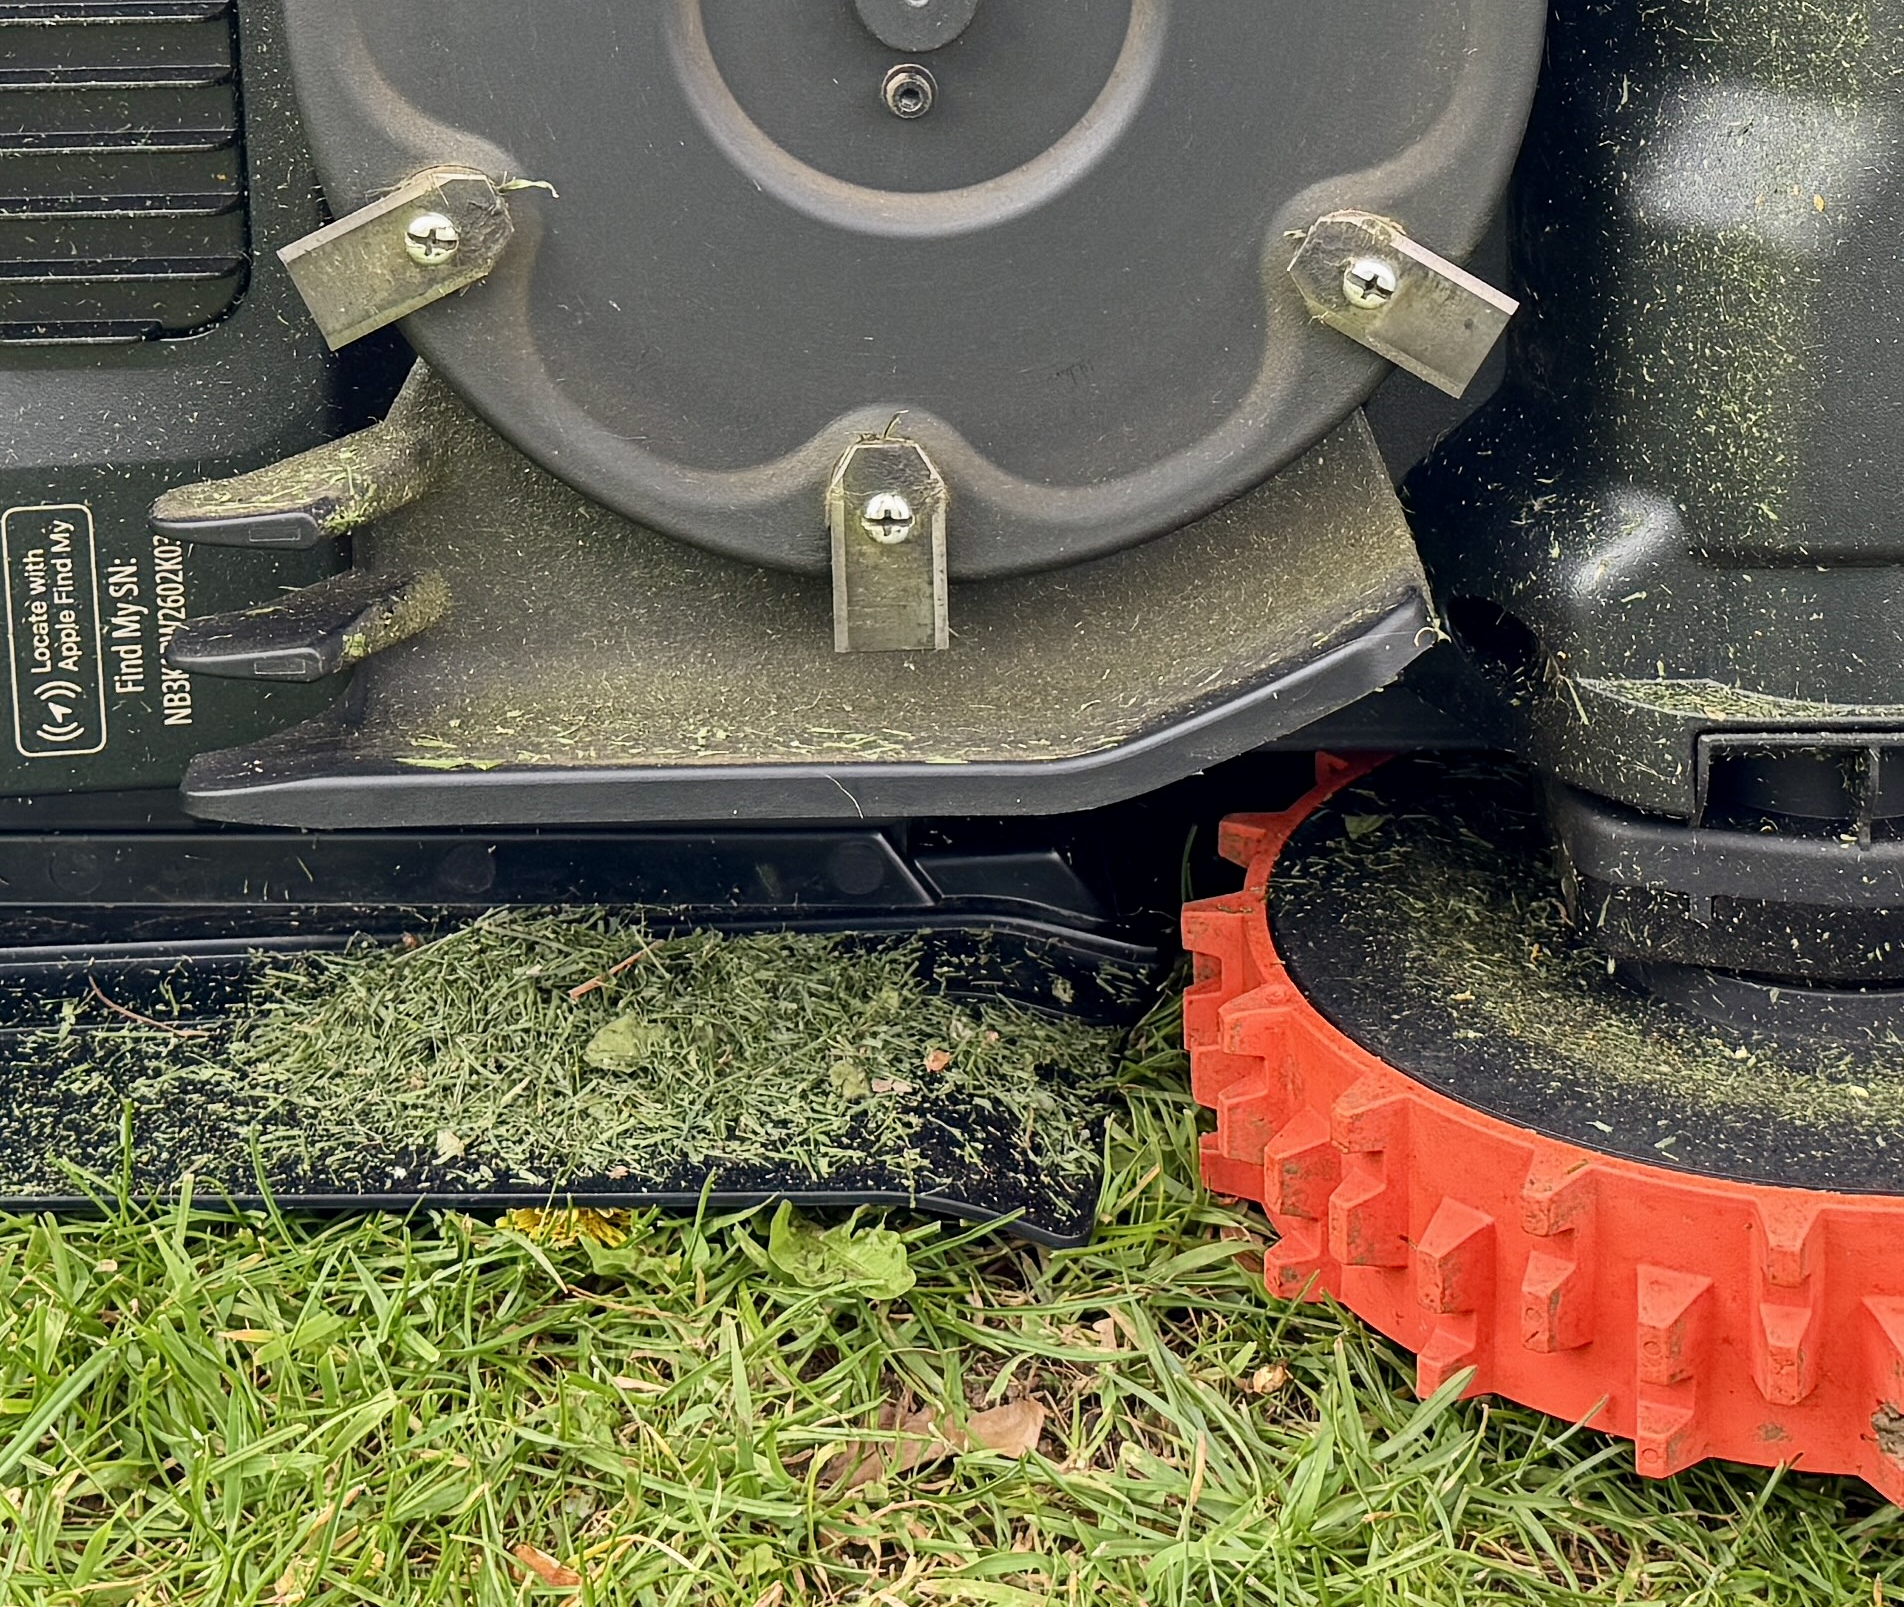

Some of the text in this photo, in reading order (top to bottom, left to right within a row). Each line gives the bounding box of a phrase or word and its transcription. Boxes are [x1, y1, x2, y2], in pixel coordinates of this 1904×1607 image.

[23, 548, 52, 674] Locate with
[50, 519, 82, 671] Apple Find My
[109, 557, 148, 693] Find My SN:
